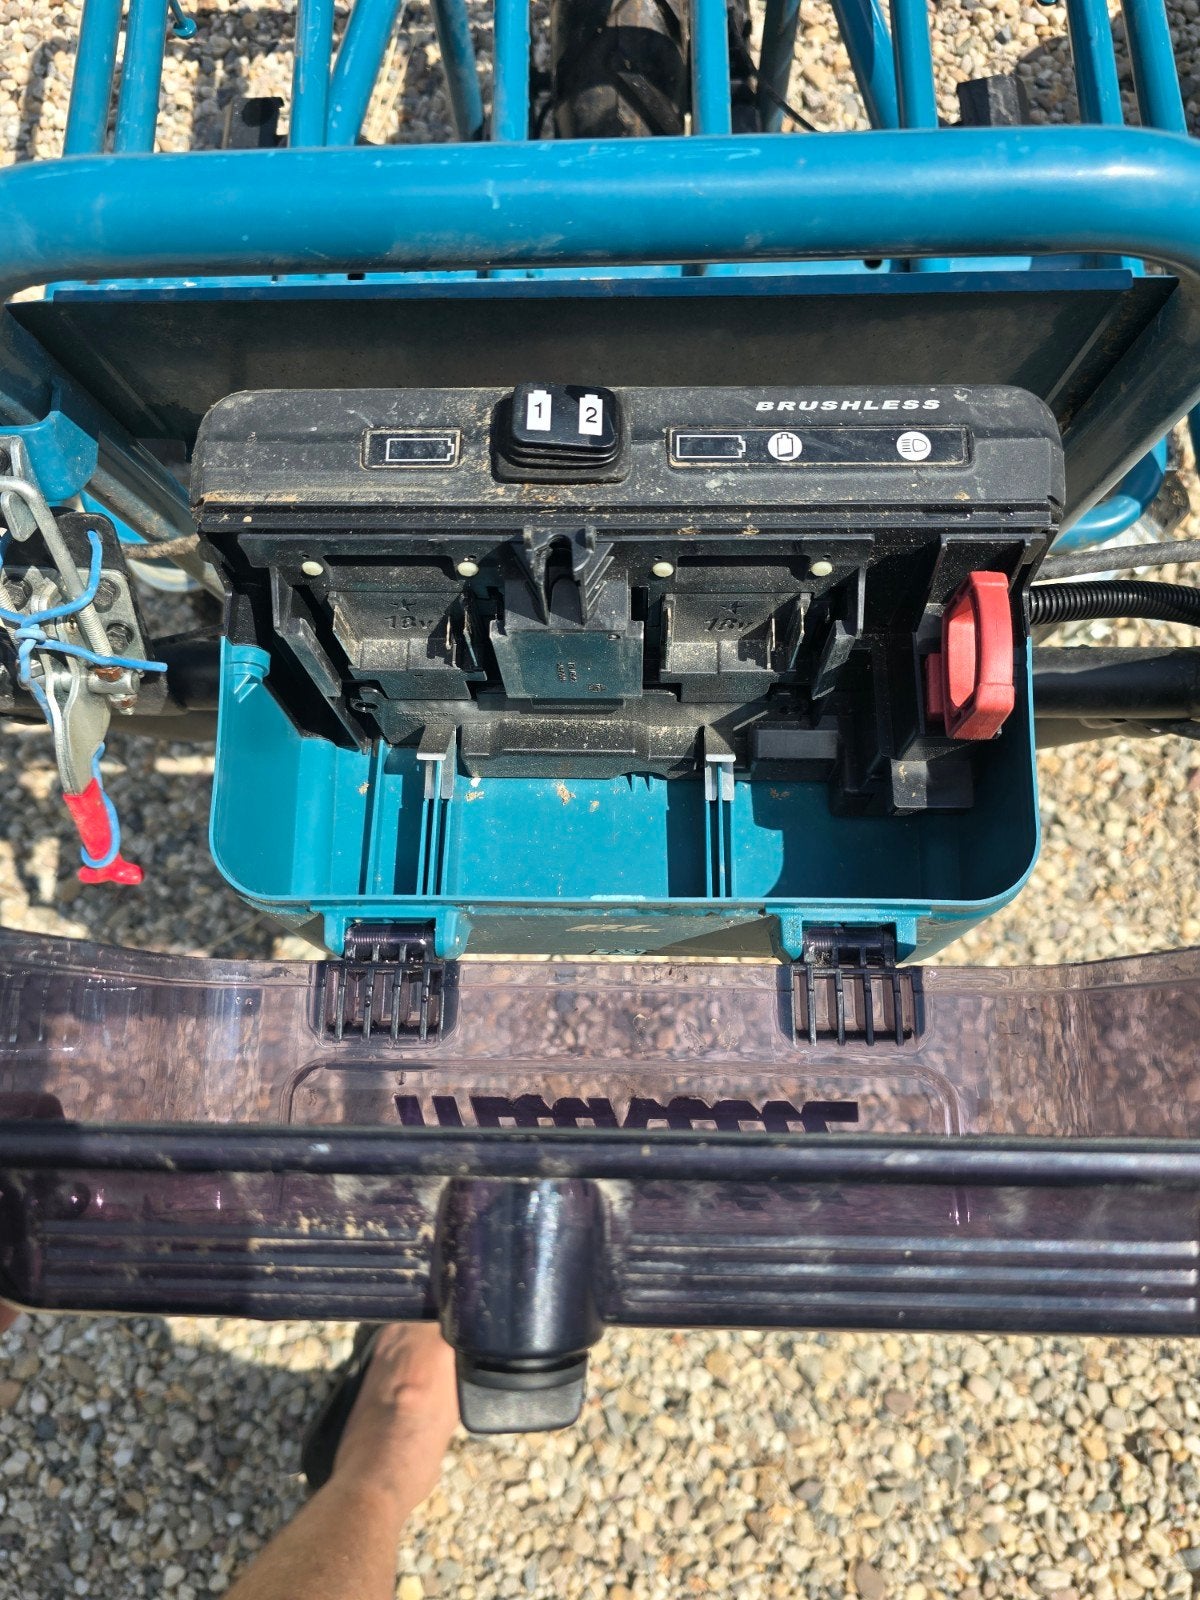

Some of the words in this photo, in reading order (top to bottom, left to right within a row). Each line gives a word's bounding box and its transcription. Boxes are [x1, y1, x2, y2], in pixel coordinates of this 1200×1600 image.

[534, 402, 542, 418] 1
[755, 399, 941, 411] BRUSHLESS
[586, 407, 598, 423] 2
